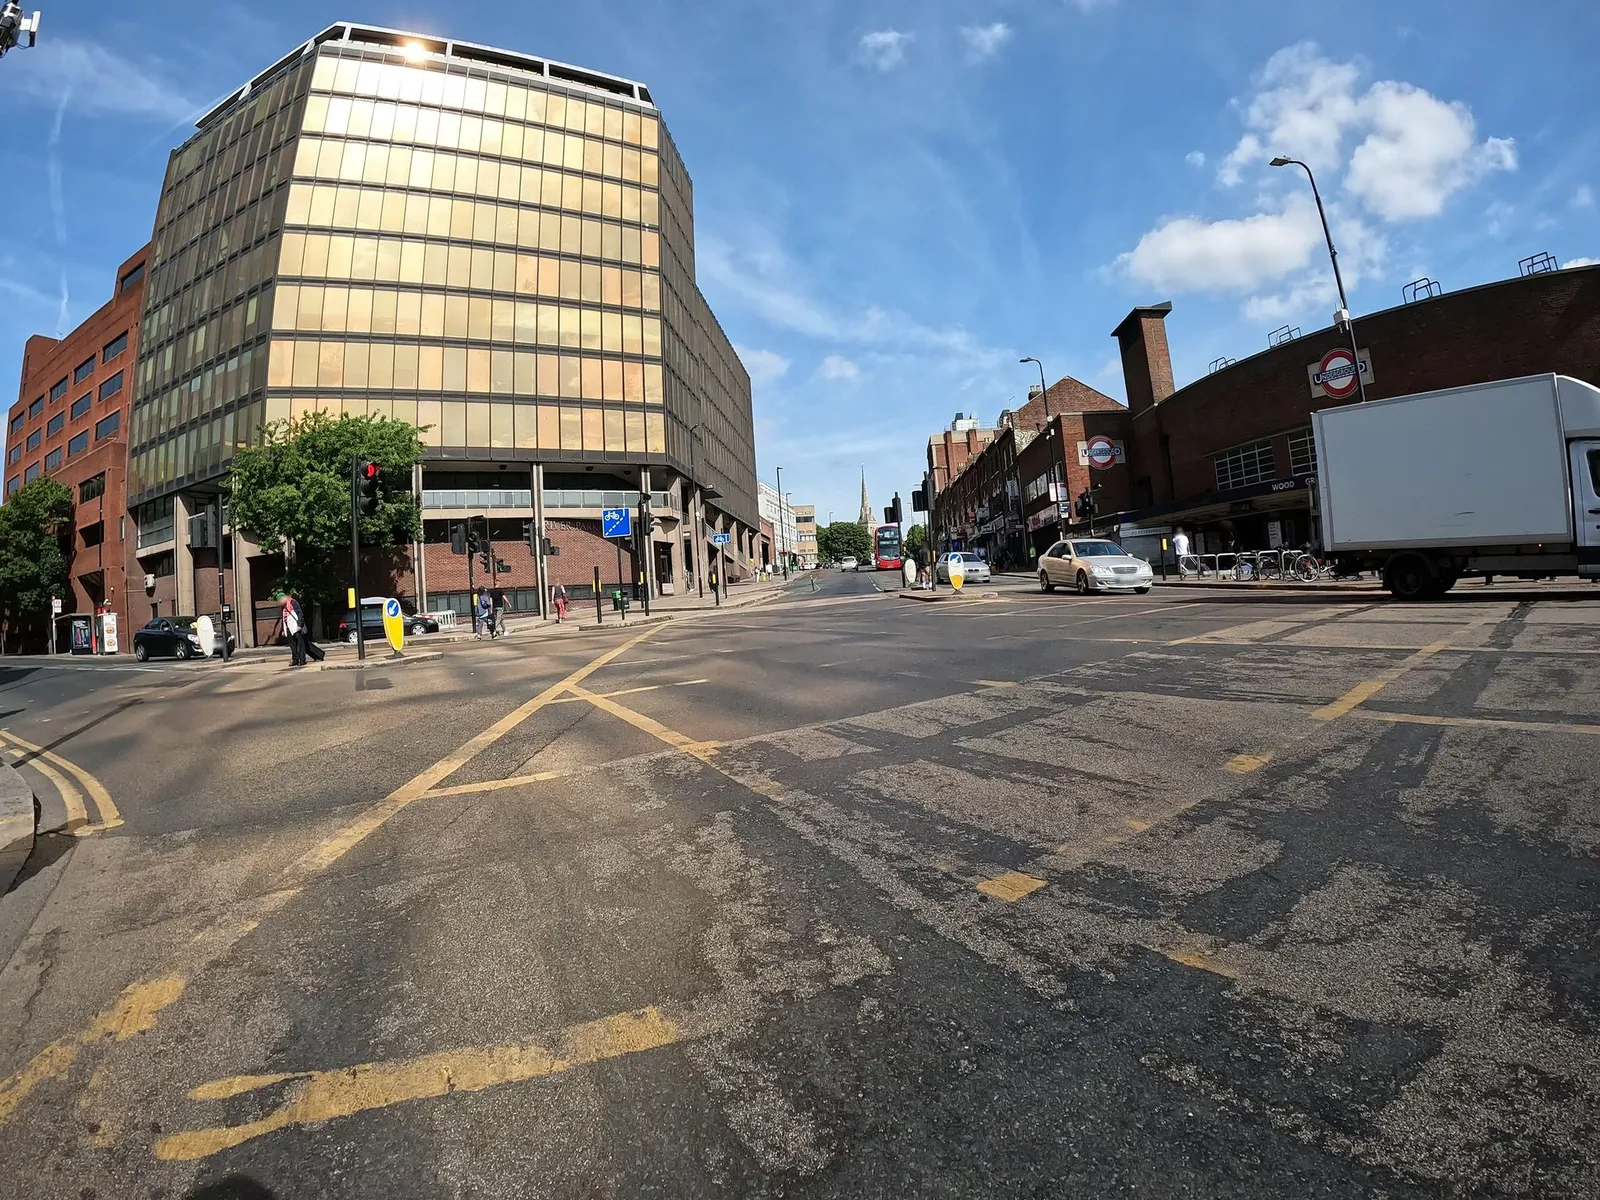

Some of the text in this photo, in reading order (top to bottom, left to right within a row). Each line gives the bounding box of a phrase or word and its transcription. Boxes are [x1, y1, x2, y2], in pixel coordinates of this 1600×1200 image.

[1271, 480, 1295, 491] WOOD
[544, 520, 599, 532] RIVER PARK
